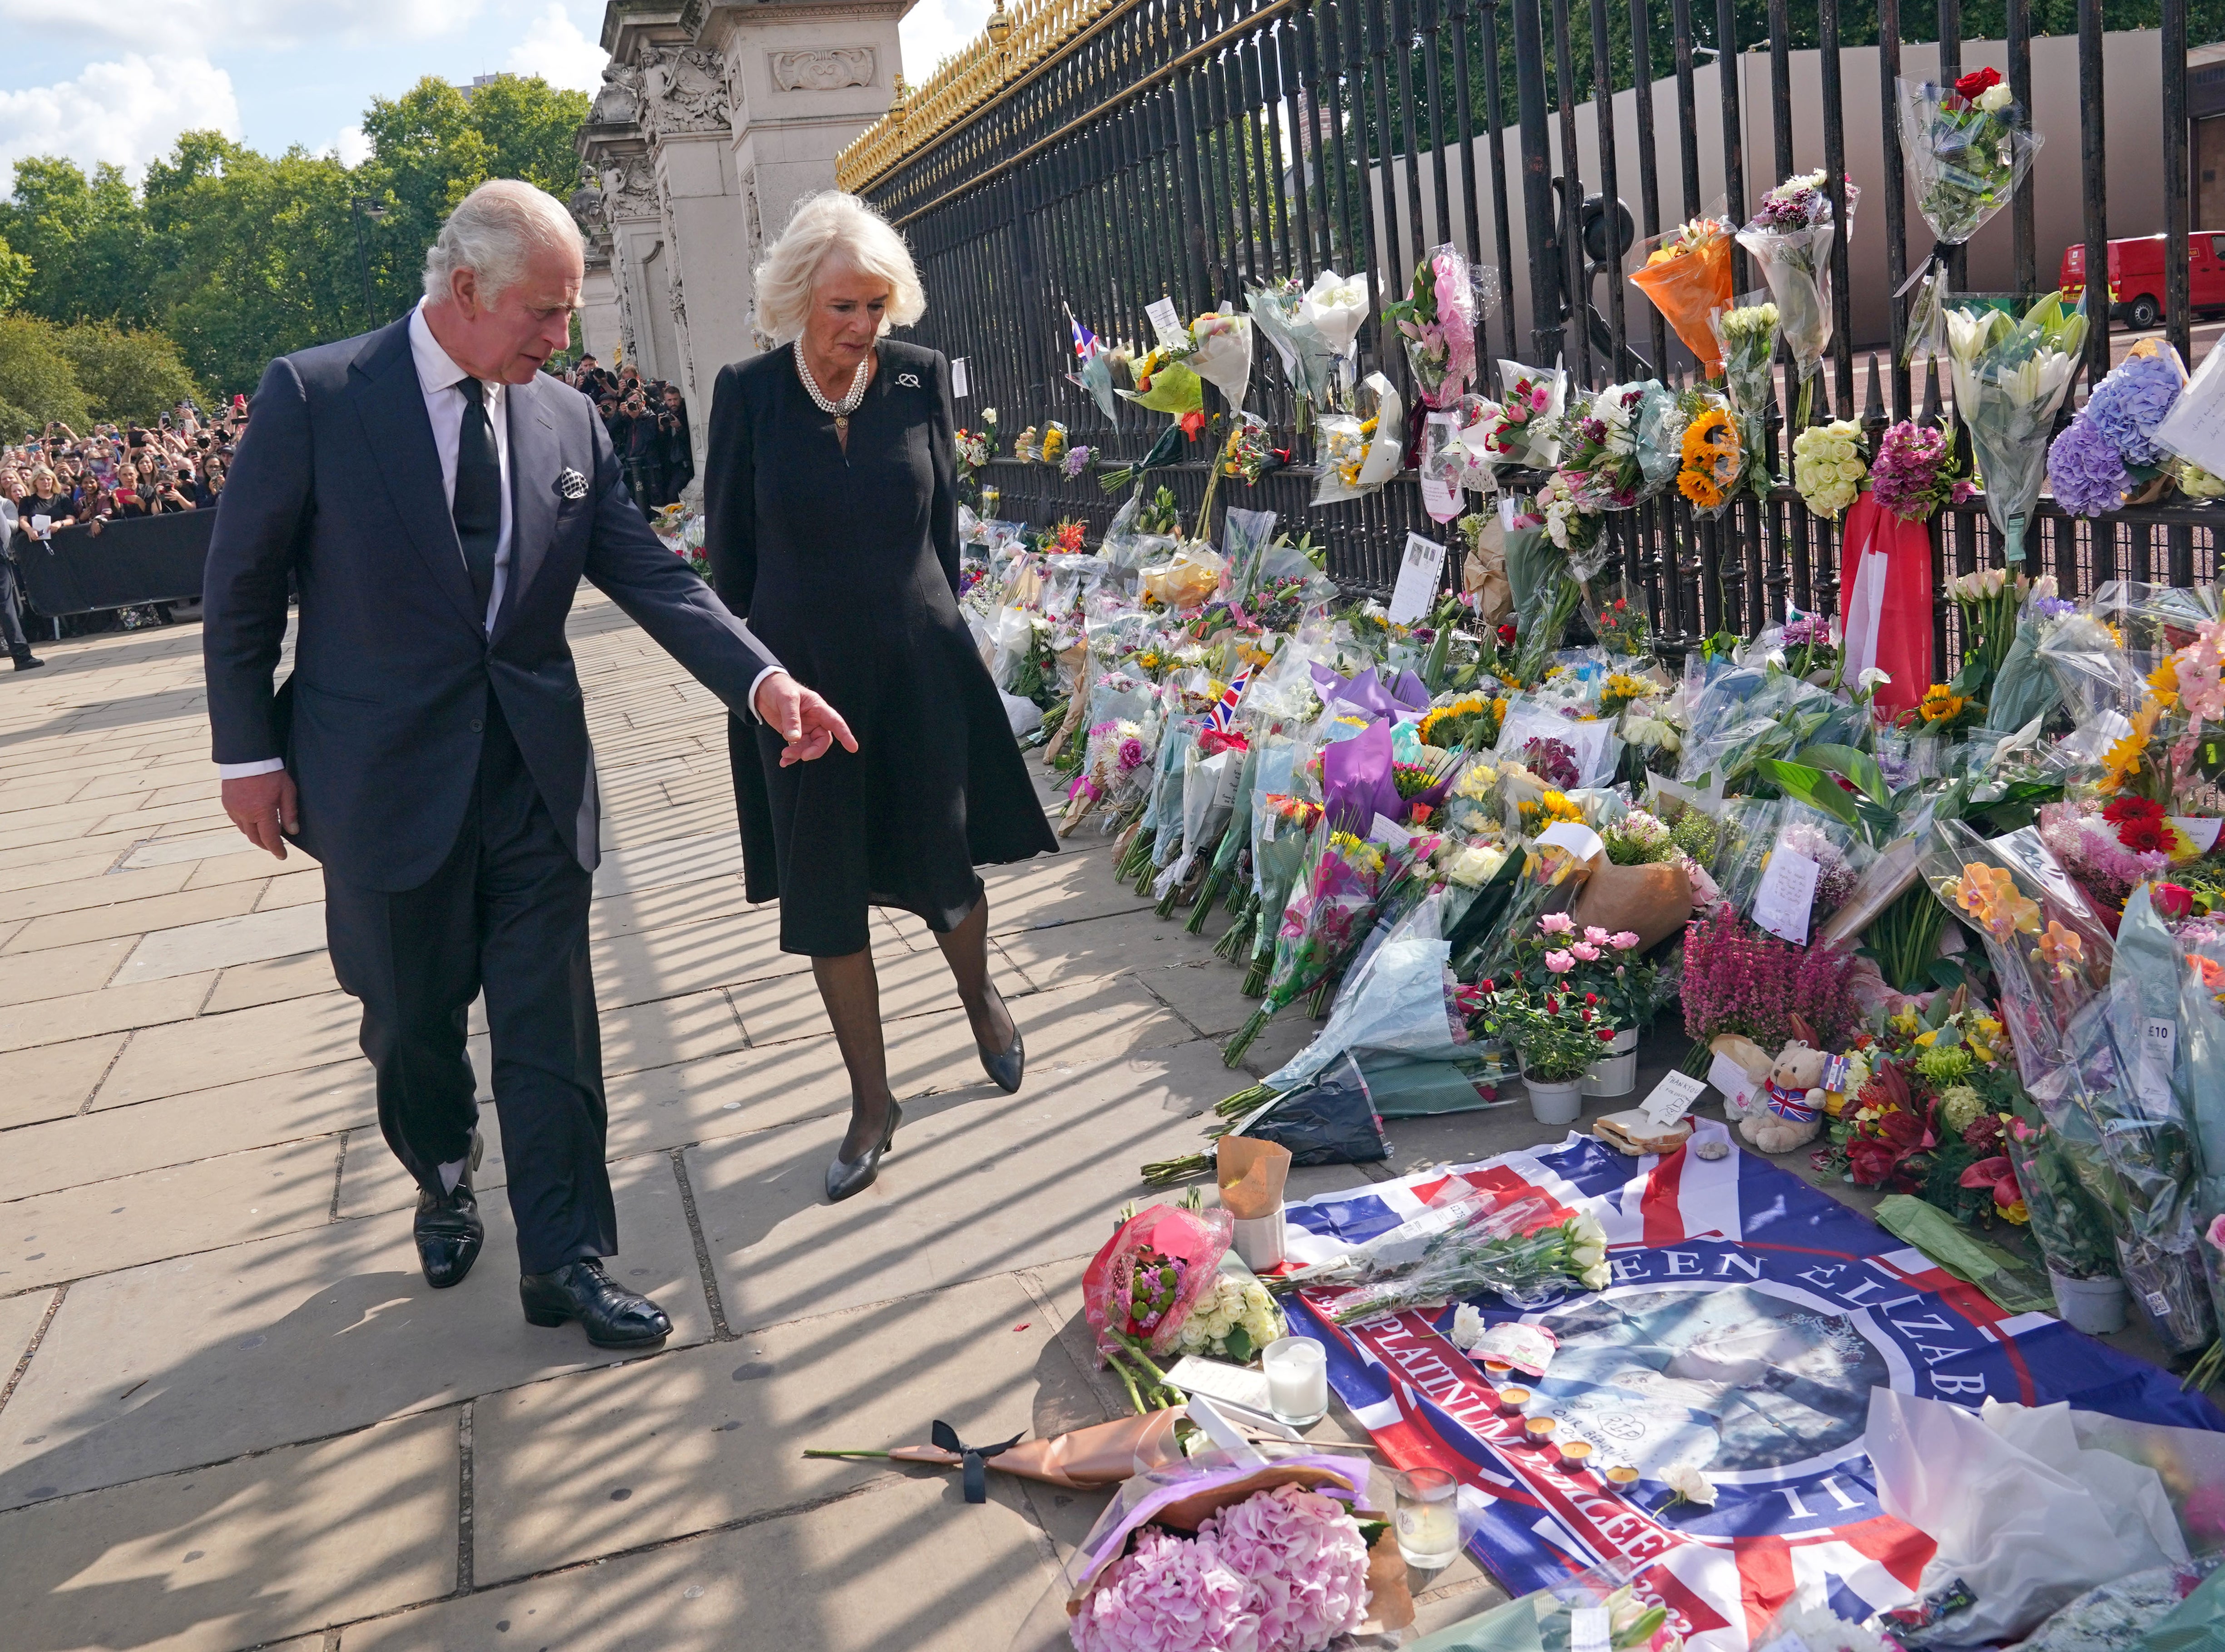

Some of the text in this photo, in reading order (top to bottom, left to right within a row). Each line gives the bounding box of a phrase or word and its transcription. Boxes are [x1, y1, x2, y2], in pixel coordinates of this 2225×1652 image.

[2147, 1026, 2168, 1038] £10
[1450, 1205, 1466, 1219] £2.75
[1361, 1315, 1526, 1446] PLATINUM
[1552, 1409, 1583, 1429] OUR
[1493, 1444, 1672, 1566] JUBILEE
